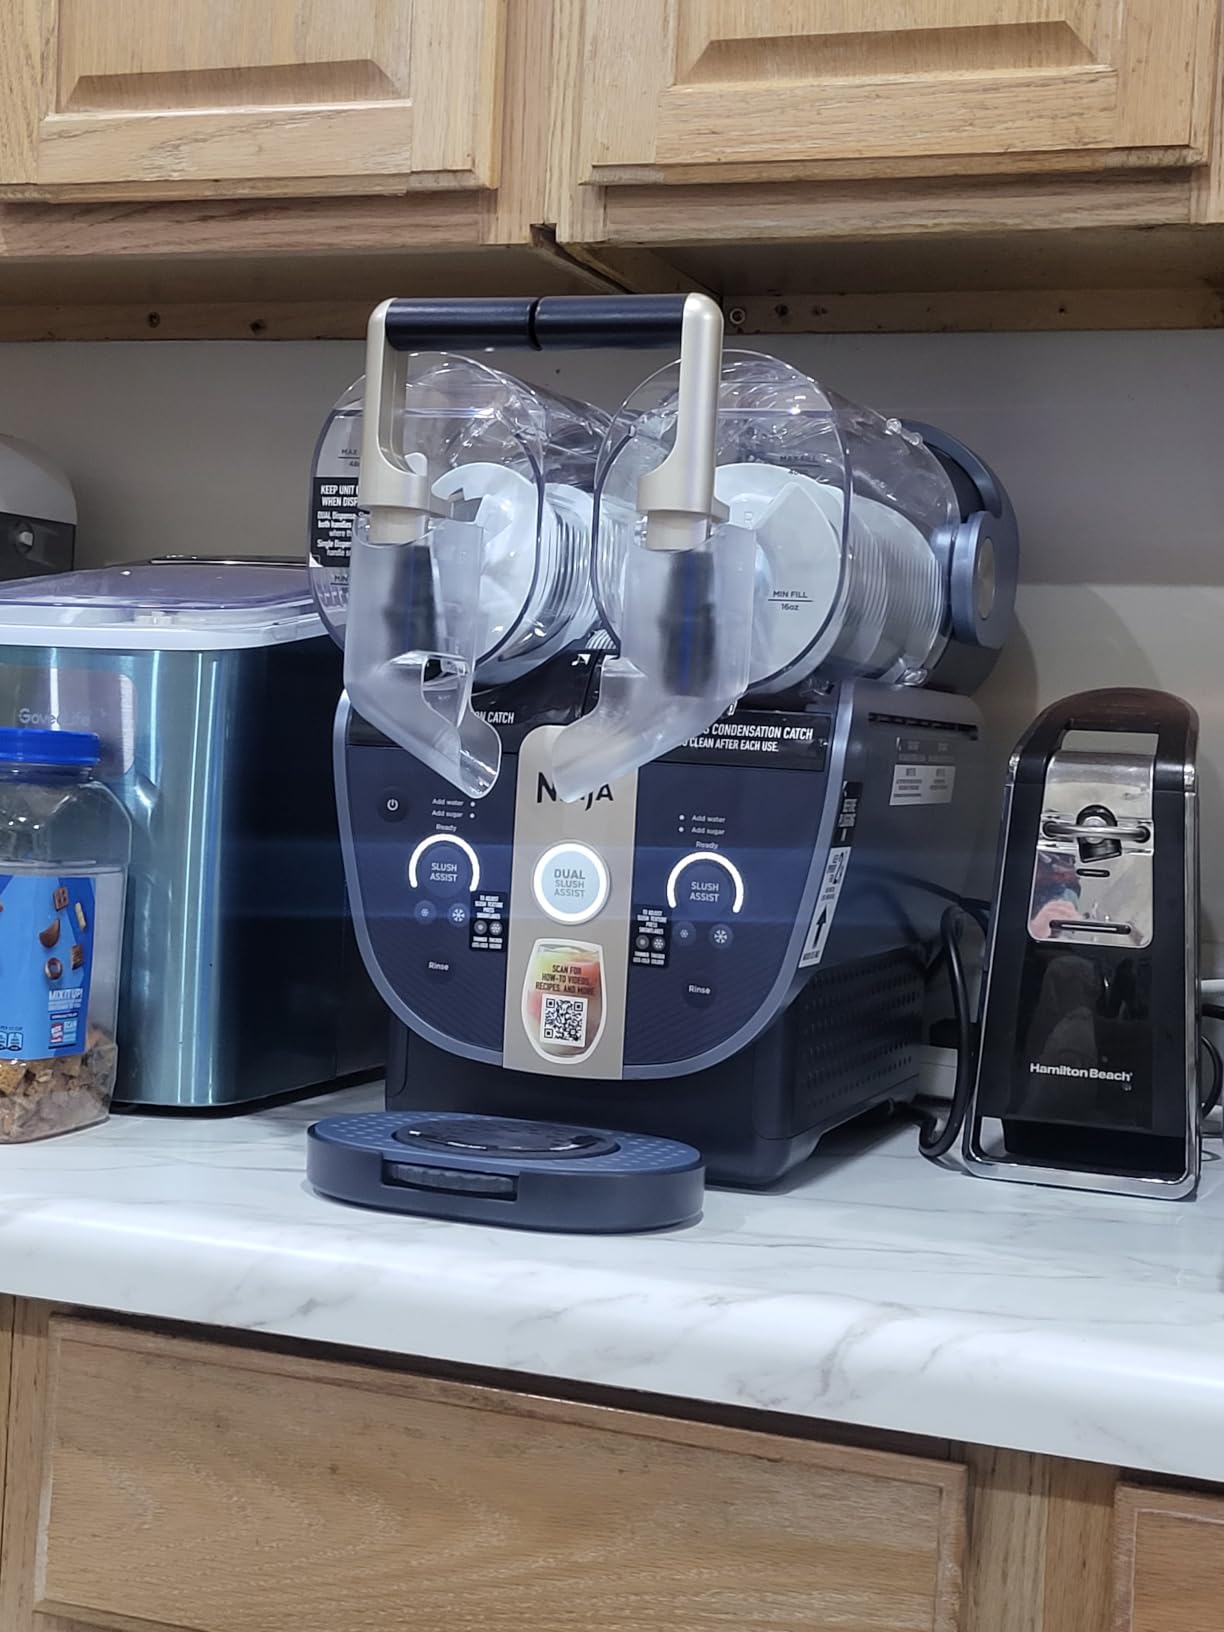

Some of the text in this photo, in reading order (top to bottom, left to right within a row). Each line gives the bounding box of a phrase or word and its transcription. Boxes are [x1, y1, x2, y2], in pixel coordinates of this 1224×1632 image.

[320, 485, 339, 495] KEEP
[339, 485, 355, 495] UNIT
[321, 497, 342, 507] WHEN
[773, 590, 809, 600] MIN FILL
[781, 602, 800, 611] 16oz
[487, 711, 515, 724] CATCH
[711, 723, 782, 739] CONDENSATION
[783, 726, 814, 741] CATCH
[689, 736, 714, 749] CLEAN
[715, 738, 739, 750] AFTER
[740, 739, 760, 751] EACH
[761, 740, 779, 753] USE.
[432, 798, 446, 806] Add
[435, 823, 457, 833] Ready
[706, 828, 725, 836] sugar
[695, 840, 719, 850] Ready
[431, 862, 458, 873] SLUSH
[429, 873, 458, 883] ASSIST
[554, 868, 586, 880] DUAL
[554, 879, 585, 889] SLUSH
[690, 881, 720, 892] SLUSH
[554, 888, 585, 898] ASSIST
[689, 892, 720, 903] ASSIST
[428, 961, 450, 971] Rinse
[552, 964, 582, 975] SCAN FOR
[541, 973, 567, 983] HOW-TO
[563, 984, 577, 993] AND
[688, 985, 711, 995] Rinse
[1030, 1063, 1131, 1082] Hamilton Beach
